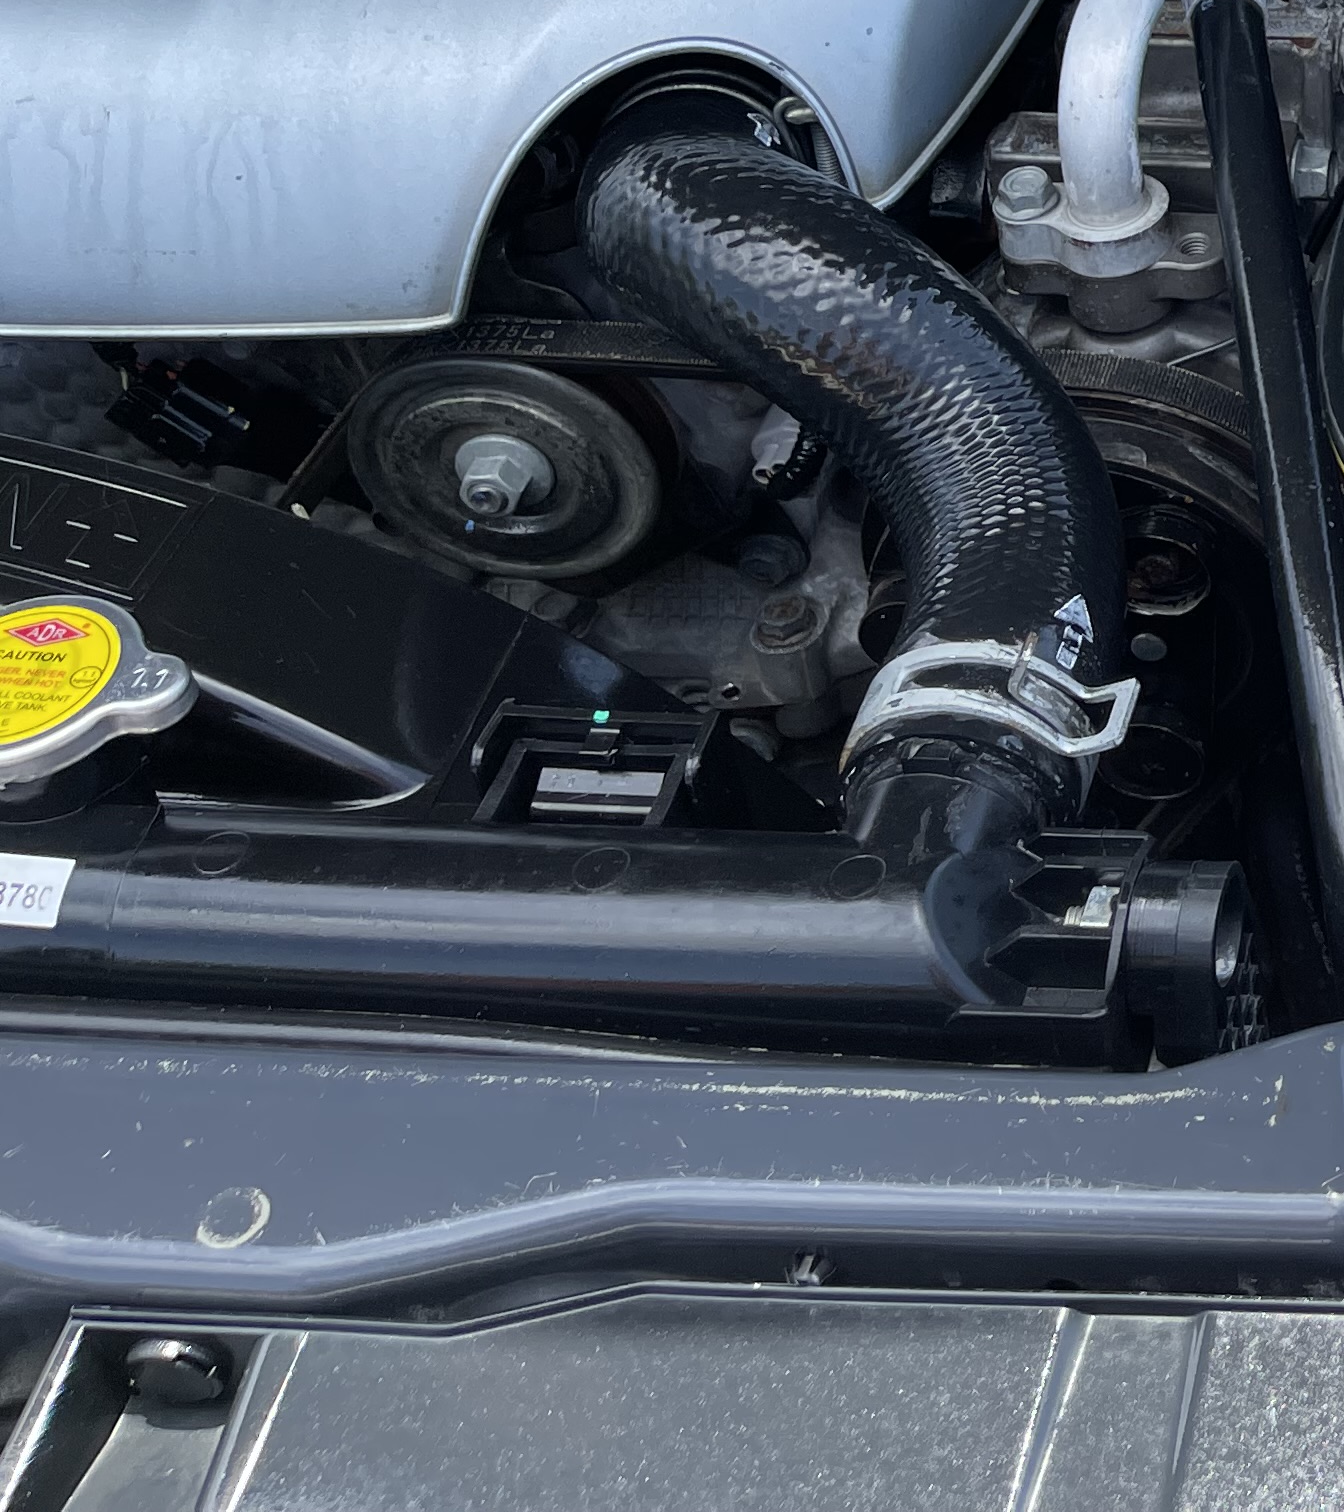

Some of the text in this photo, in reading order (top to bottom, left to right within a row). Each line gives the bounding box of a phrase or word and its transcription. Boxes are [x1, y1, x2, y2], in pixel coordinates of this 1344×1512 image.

[26, 624, 68, 642] ADR
[25, 668, 66, 678] NEVER
[131, 667, 170, 690] 1.1
[35, 679, 61, 688] HOT
[14, 691, 71, 703] COOLANT
